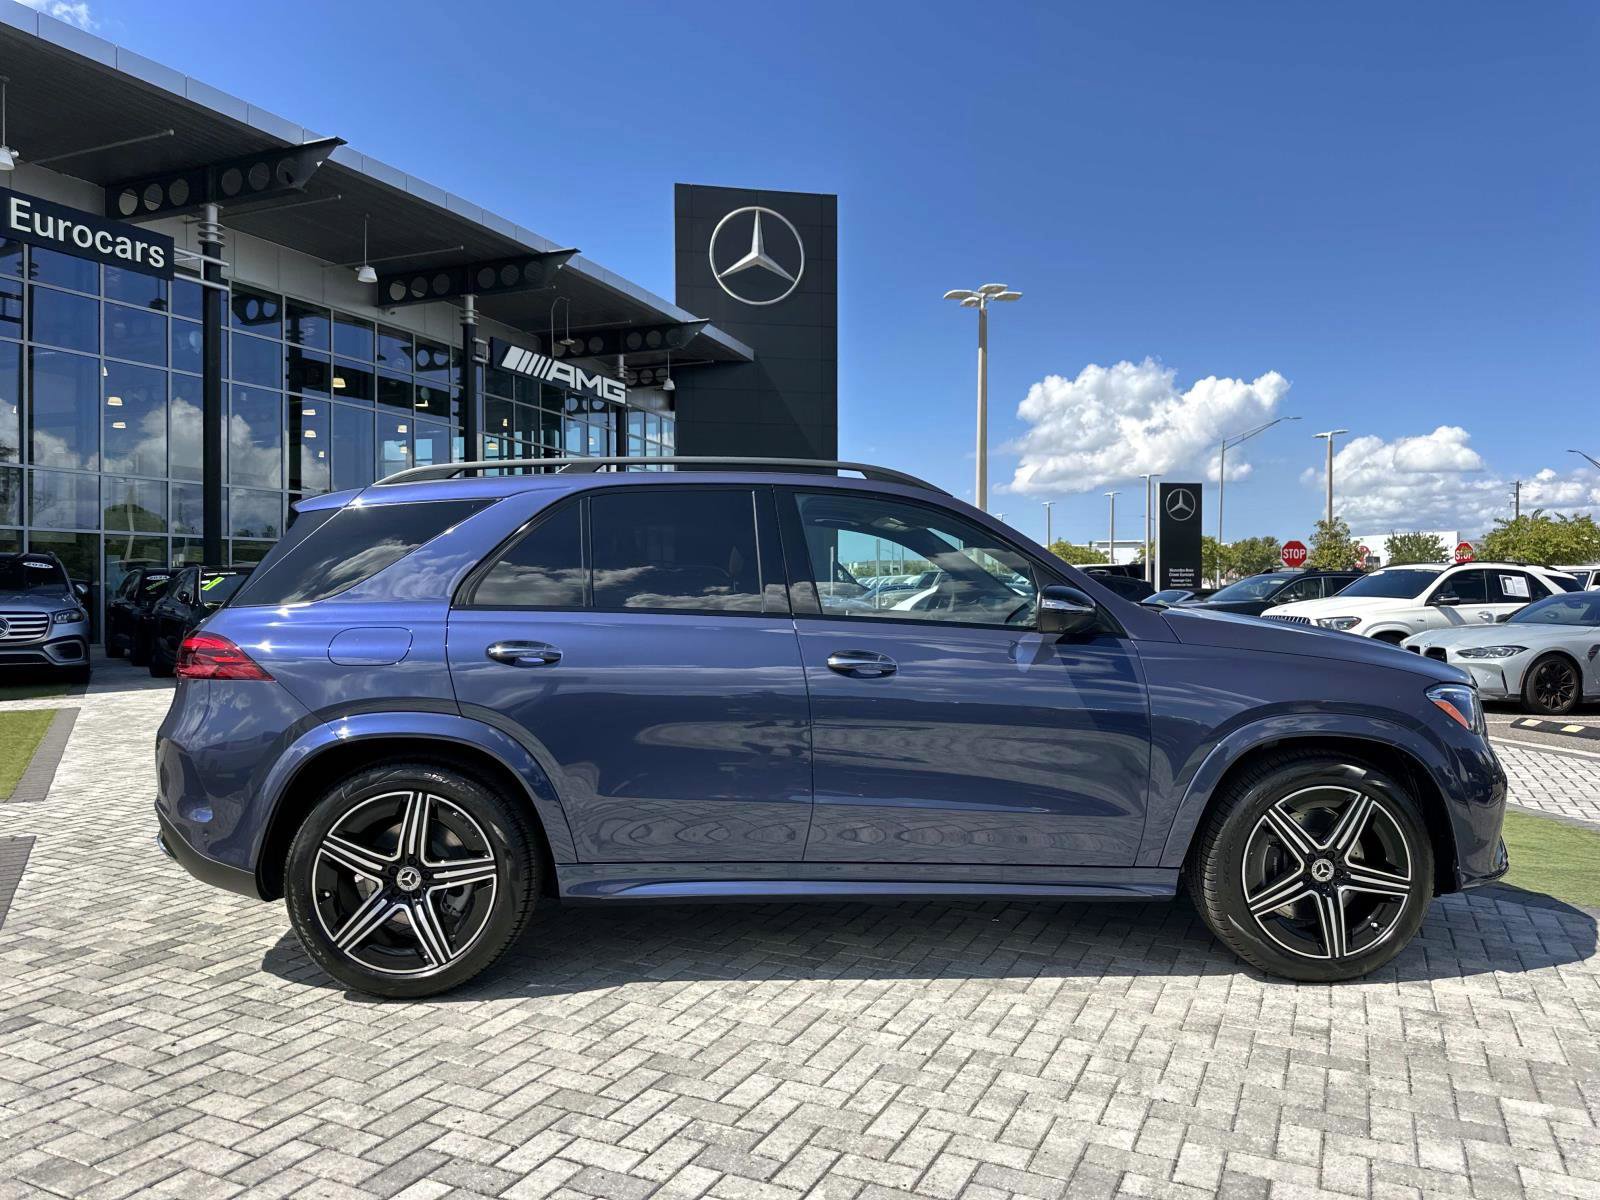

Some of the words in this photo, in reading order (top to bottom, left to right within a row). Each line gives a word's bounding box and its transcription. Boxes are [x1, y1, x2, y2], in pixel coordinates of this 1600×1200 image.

[10, 197, 165, 268] Eurocars
[546, 360, 626, 404] AMG
[1283, 548, 1306, 560] STOP
